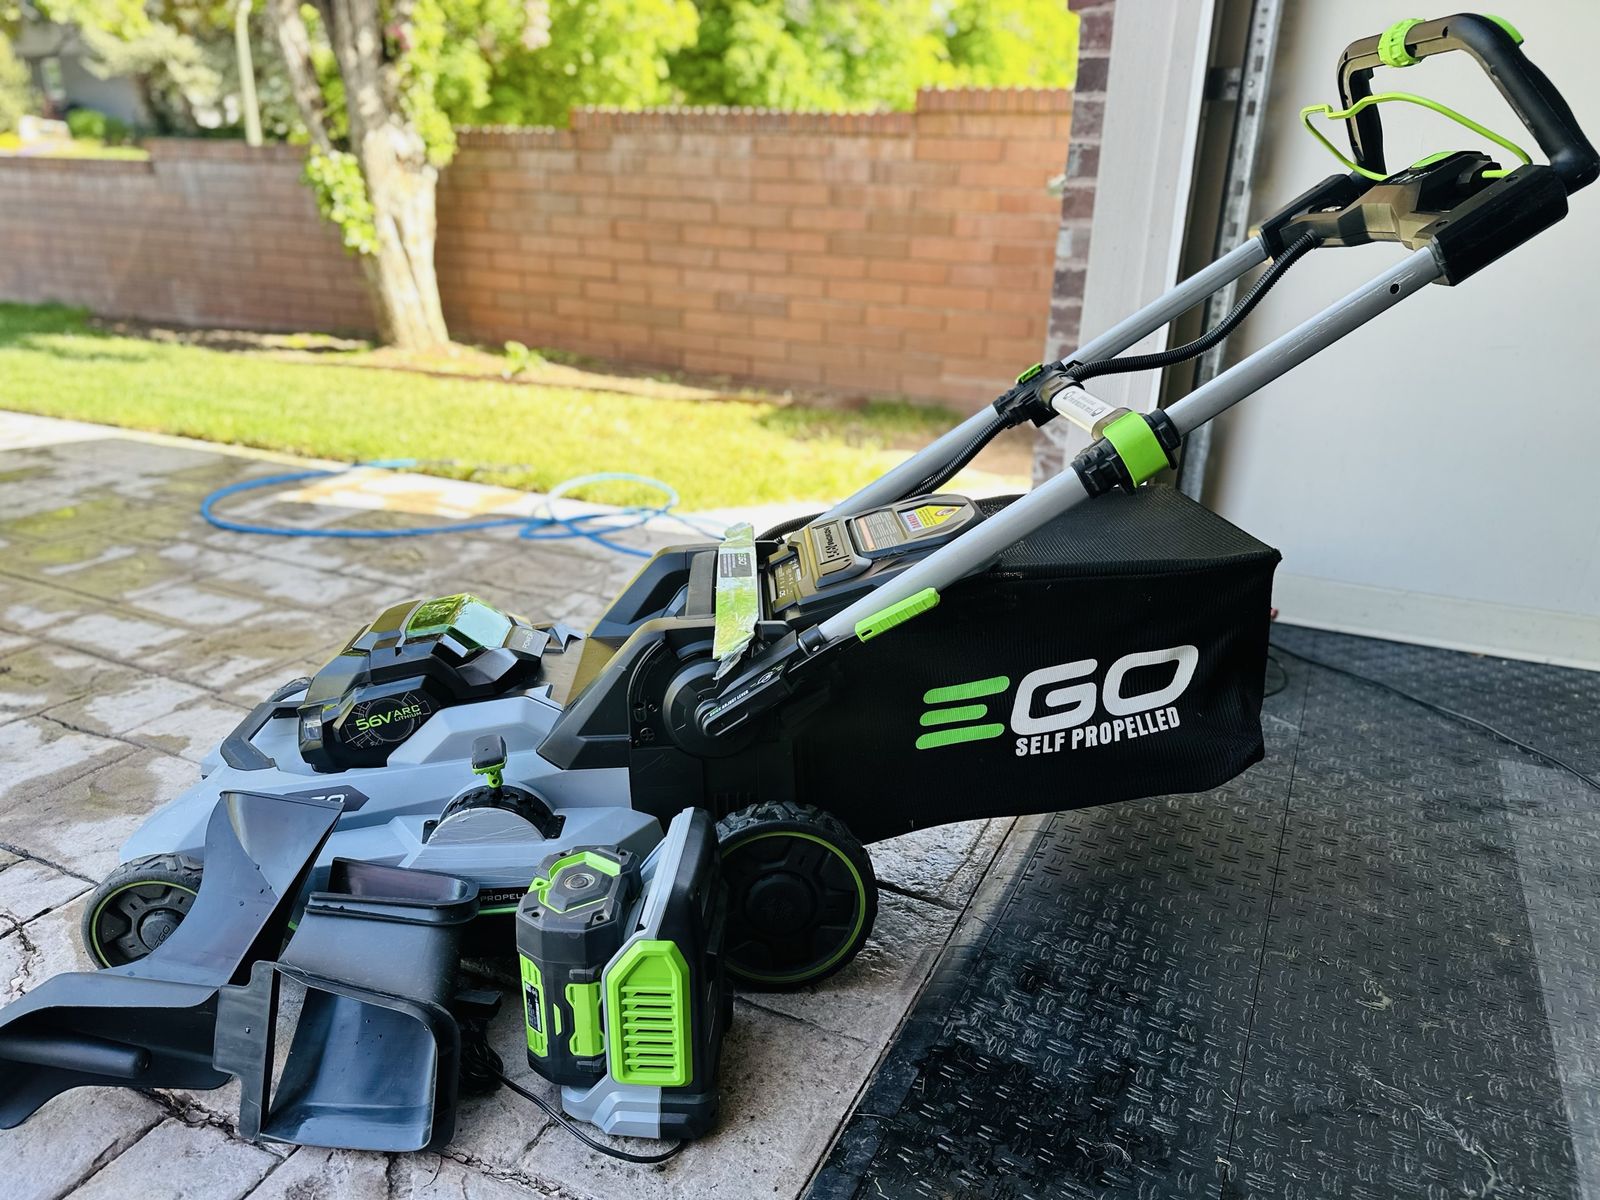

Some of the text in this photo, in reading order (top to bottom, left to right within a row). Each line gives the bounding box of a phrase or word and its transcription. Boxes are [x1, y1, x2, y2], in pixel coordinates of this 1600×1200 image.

[394, 711, 422, 722] LITHIUM
[915, 644, 1199, 750] EGO
[355, 704, 421, 731] 56V ARC
[1015, 706, 1181, 757] SELF PROPELLED
